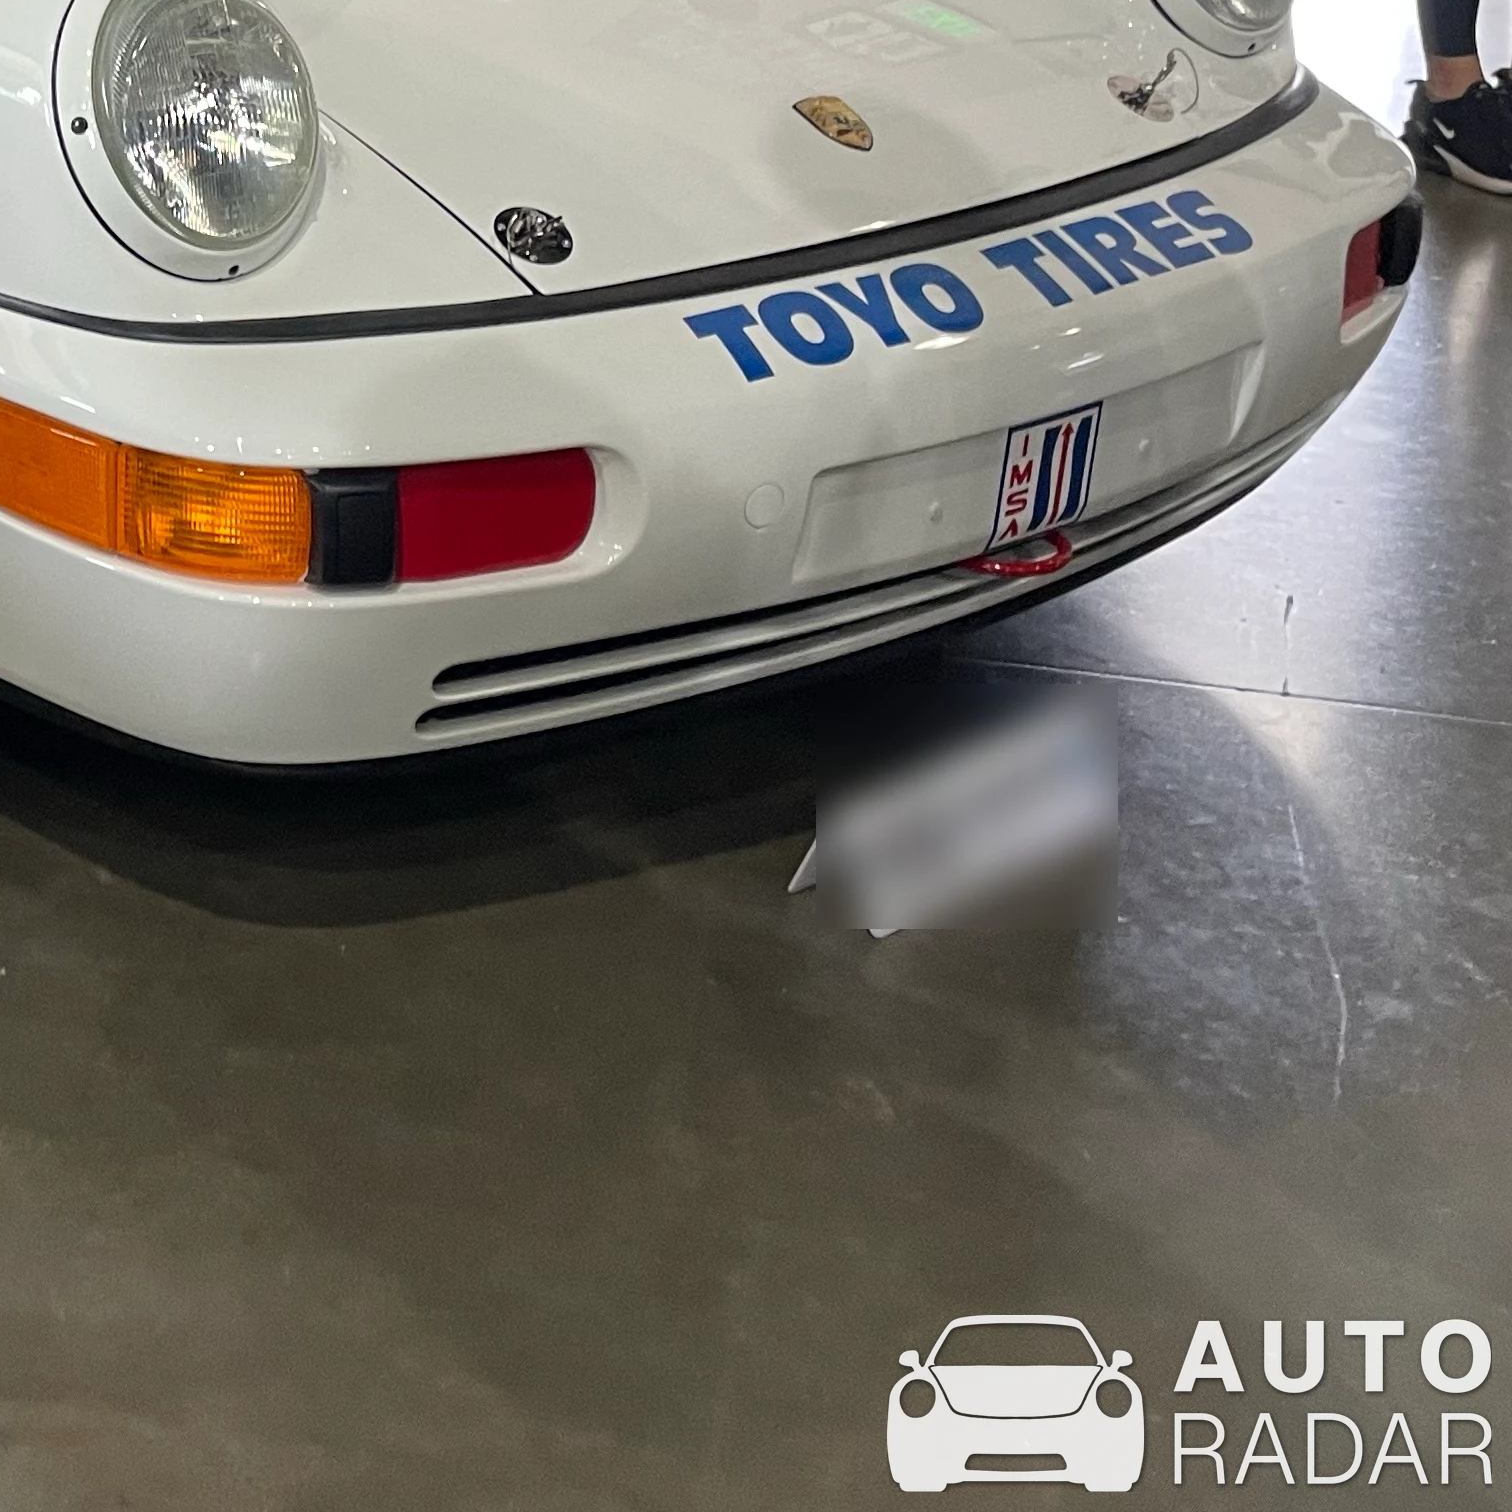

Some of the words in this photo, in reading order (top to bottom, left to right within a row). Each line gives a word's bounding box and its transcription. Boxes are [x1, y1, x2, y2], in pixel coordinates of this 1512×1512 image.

[683, 262, 984, 382] TOYO
[981, 189, 1253, 307] TIRES
[997, 432, 1034, 543] IMSA
